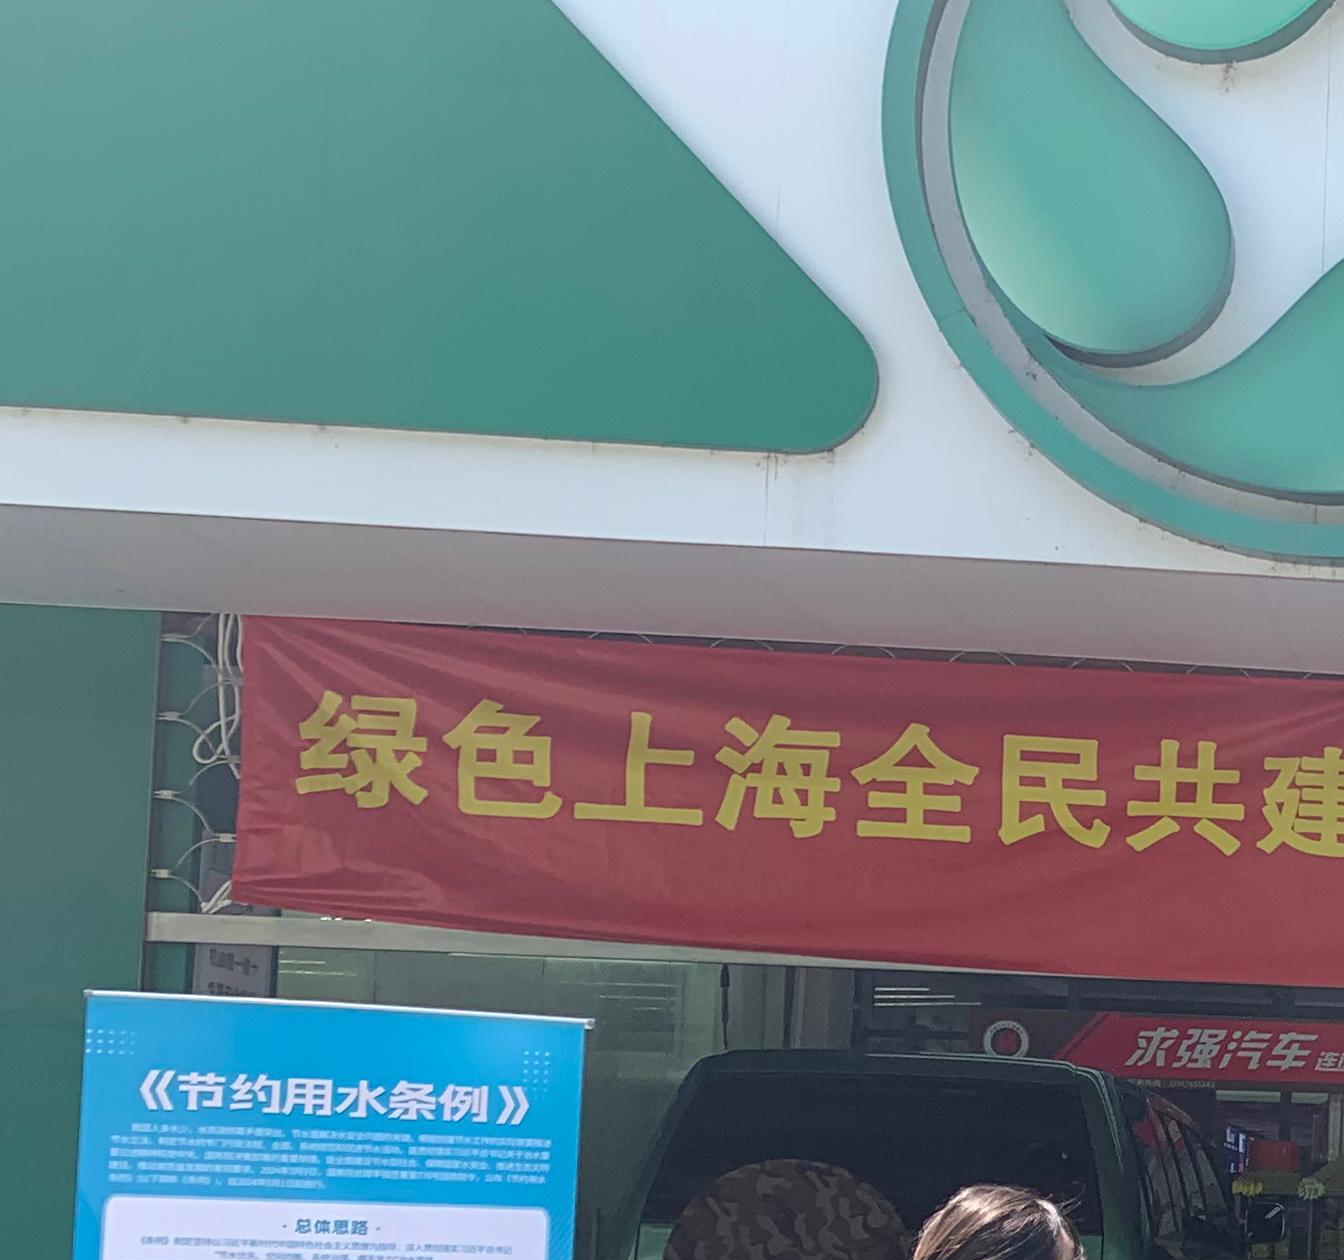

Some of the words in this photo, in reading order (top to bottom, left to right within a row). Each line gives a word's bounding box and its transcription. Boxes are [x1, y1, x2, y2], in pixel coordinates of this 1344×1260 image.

[1125, 1026, 1319, 1071] 求强汽车
[139, 1069, 530, 1127] 《节约用水条例》
[293, 1218, 369, 1236] 总体思路
